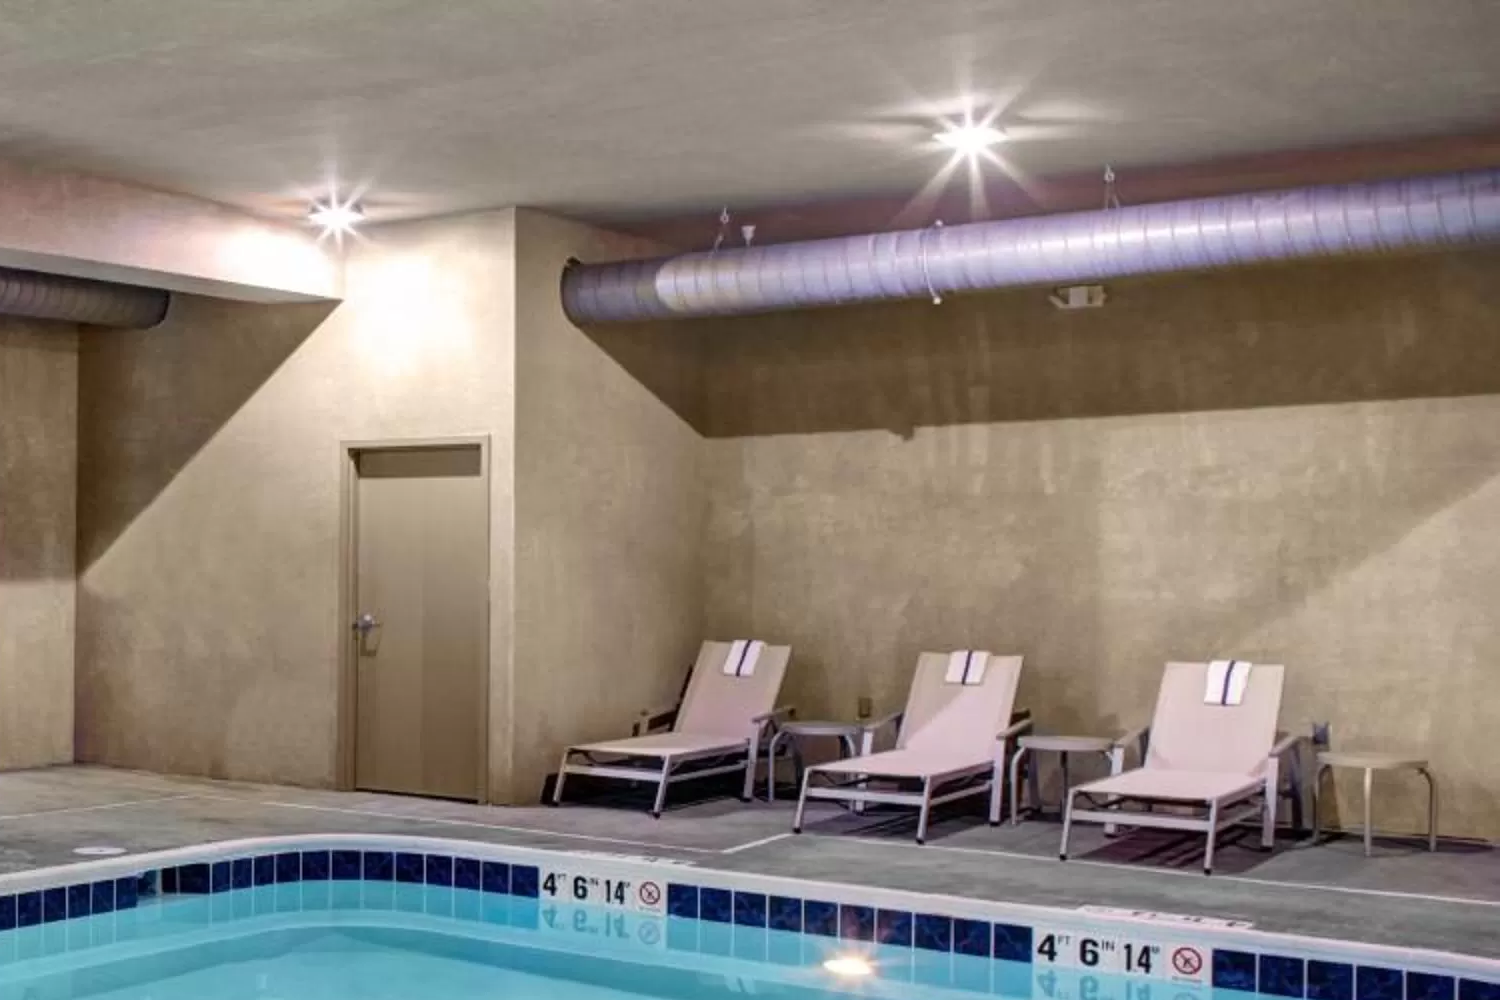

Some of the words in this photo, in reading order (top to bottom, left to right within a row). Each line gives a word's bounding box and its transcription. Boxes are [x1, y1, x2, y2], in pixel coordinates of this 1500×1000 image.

[543, 872, 557, 896] 4
[573, 876, 588, 899] 6
[1037, 934, 1057, 962] 4
[1079, 938, 1099, 967] 6
